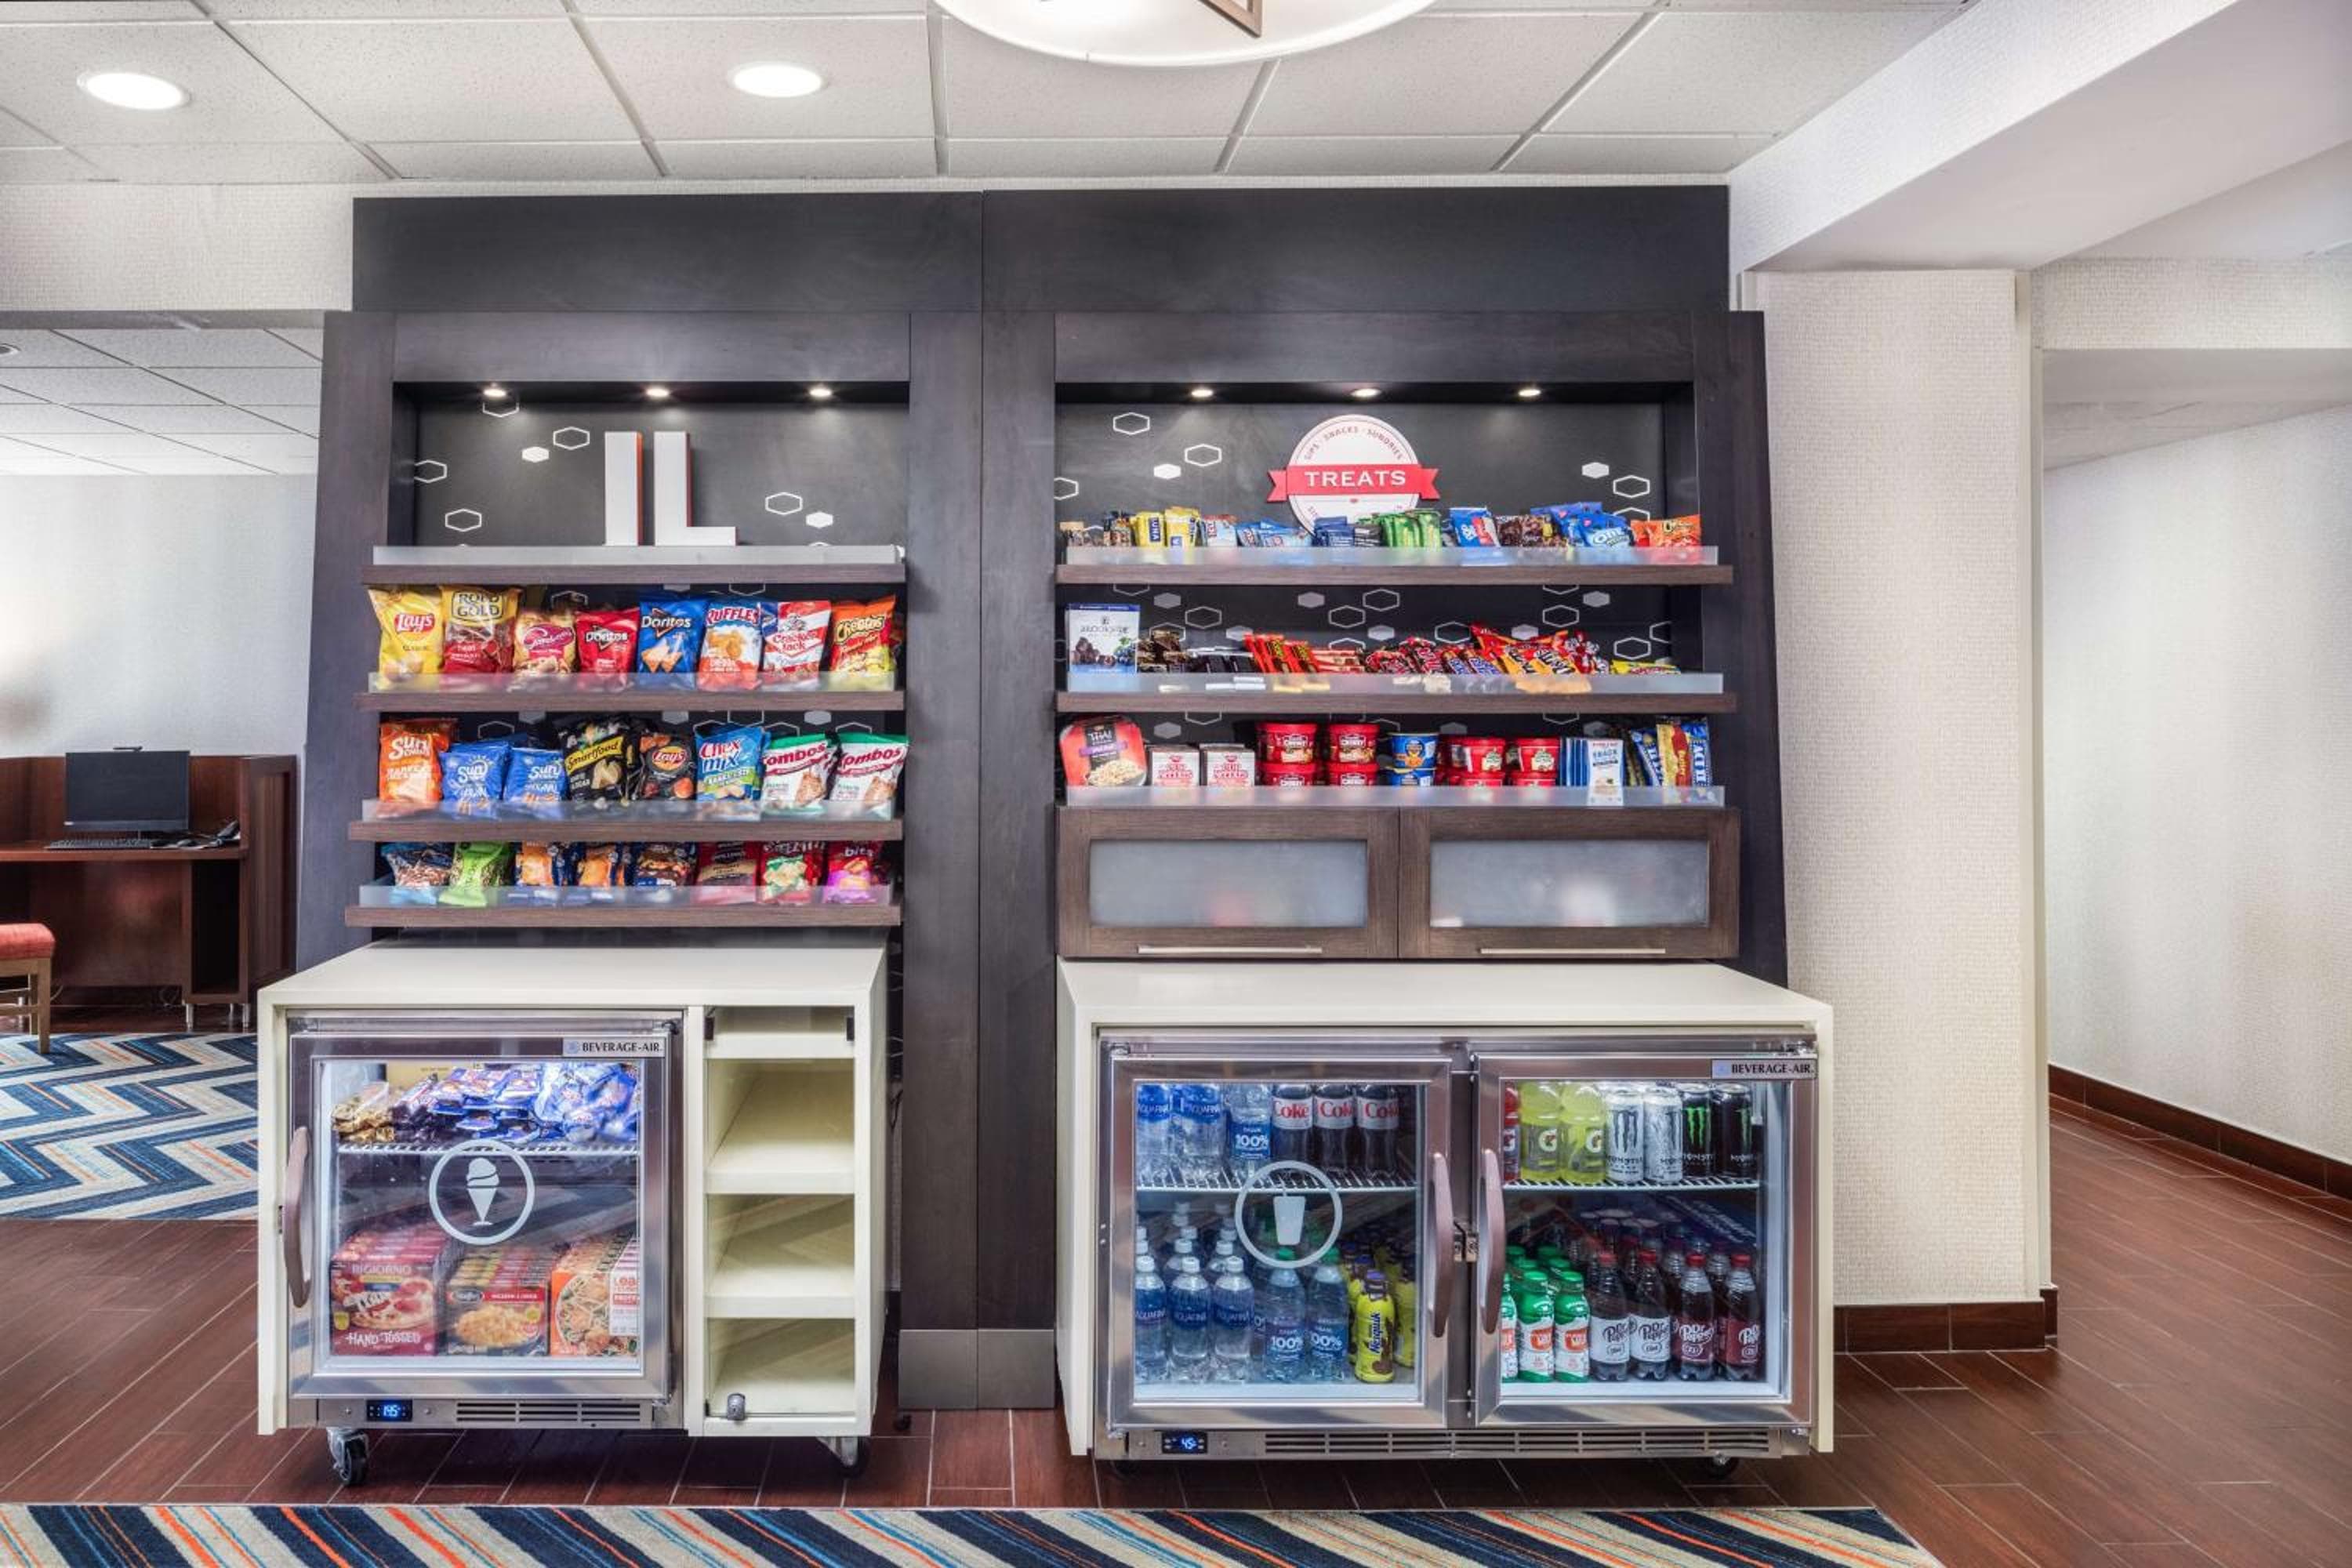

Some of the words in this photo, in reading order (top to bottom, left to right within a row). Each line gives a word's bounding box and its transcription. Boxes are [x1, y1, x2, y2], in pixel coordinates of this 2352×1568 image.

[1367, 428, 1404, 460] SUNDRIES
[1304, 470, 1406, 487] TREATS
[457, 605, 500, 617] GOLD
[707, 606, 762, 626] RUFFLES
[395, 614, 433, 633] Lay's
[641, 615, 692, 628] Doritos
[568, 741, 619, 771] Smartfood
[655, 752, 685, 764] Lay's
[583, 1042, 659, 1051] BEVERAGE-AIR
[1731, 1064, 1811, 1073] BEVERAGE-AIR
[1236, 1134, 1269, 1149] 100%
[1271, 1335, 1302, 1349] 100%
